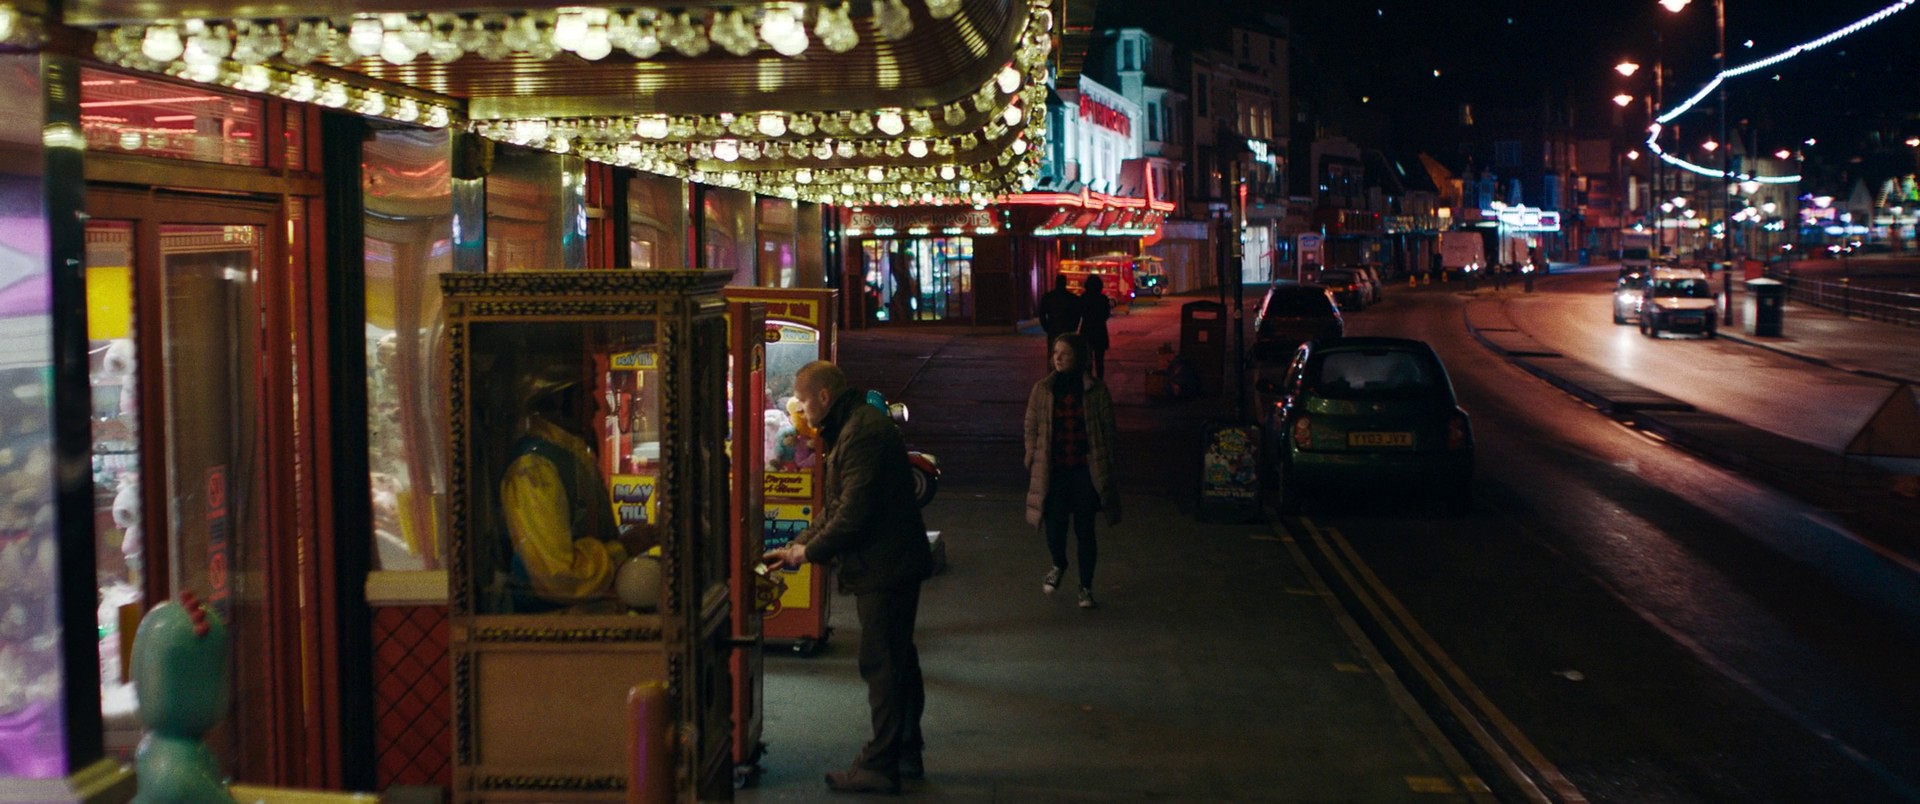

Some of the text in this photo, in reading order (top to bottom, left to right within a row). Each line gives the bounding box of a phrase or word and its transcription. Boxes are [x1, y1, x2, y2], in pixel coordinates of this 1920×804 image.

[899, 212, 992, 227] JACKPOTS
[613, 484, 653, 504] PLAY
[619, 505, 647, 524] TILL
